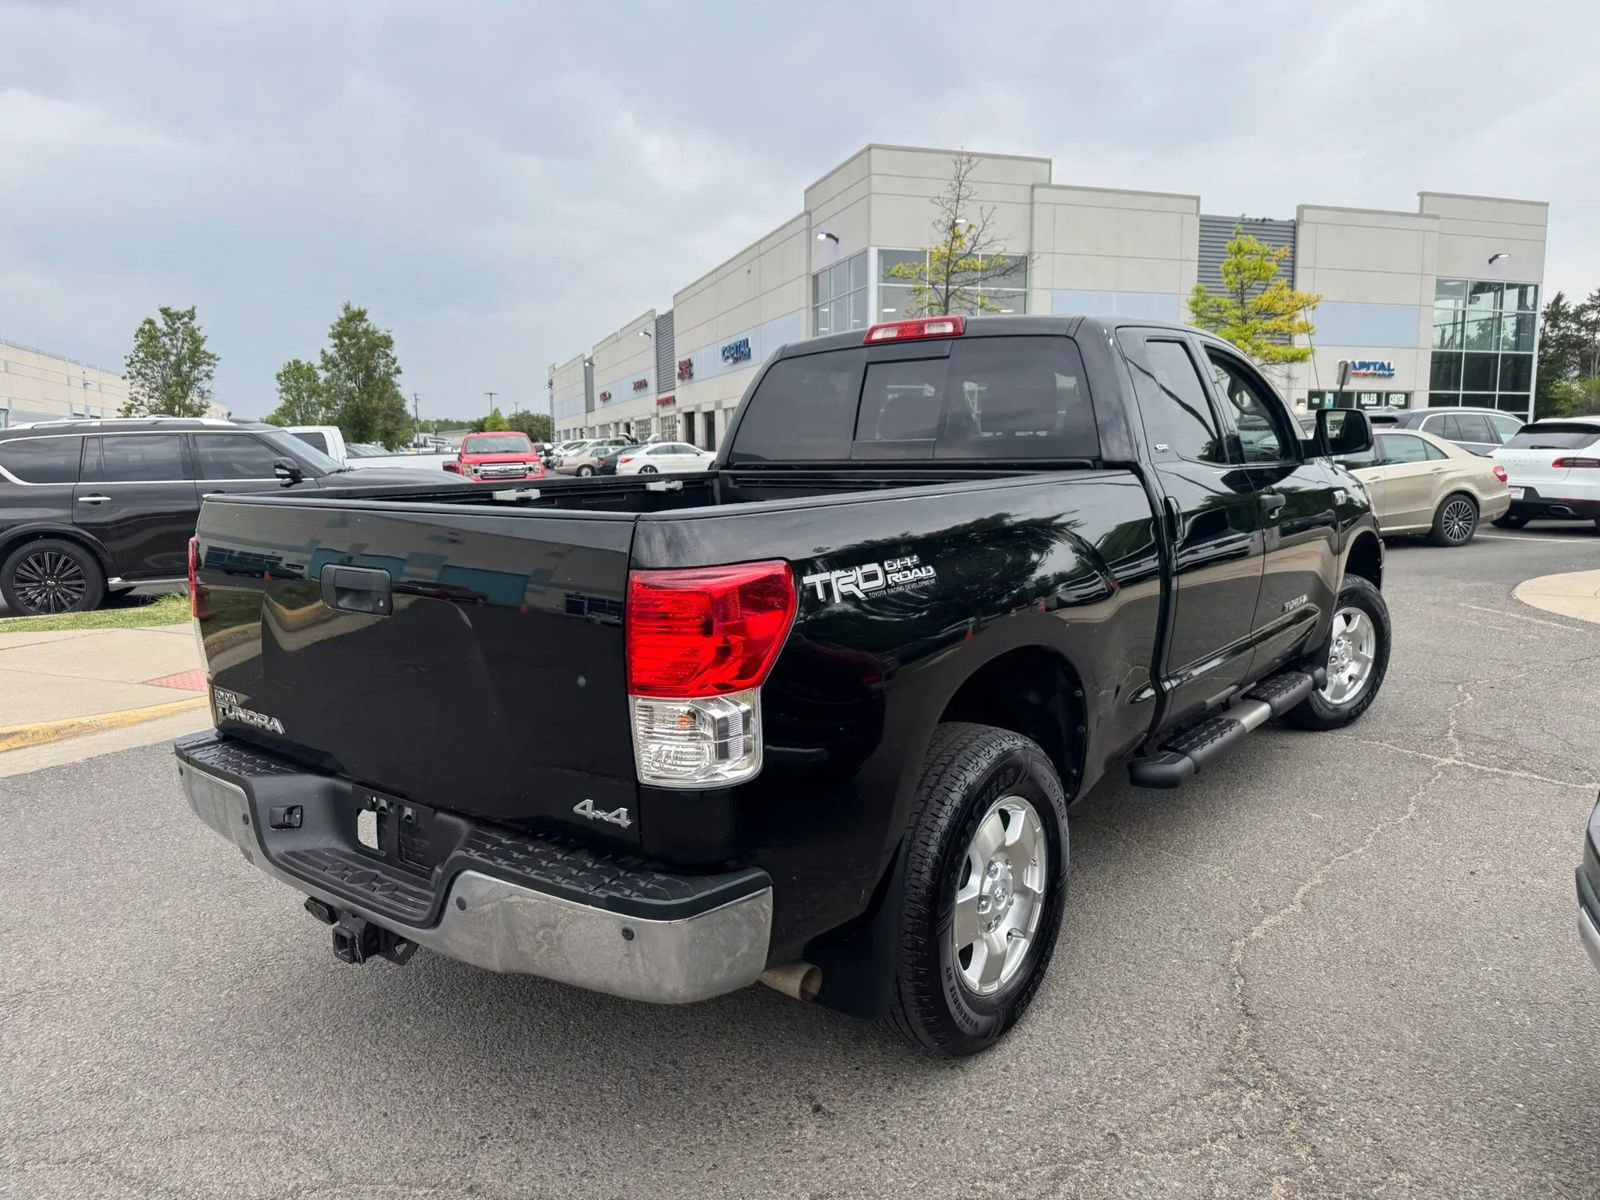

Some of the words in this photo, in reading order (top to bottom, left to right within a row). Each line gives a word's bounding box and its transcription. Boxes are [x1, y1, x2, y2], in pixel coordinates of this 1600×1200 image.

[1349, 360, 1395, 371] APITAL
[1360, 393, 1378, 405] SALES
[1389, 393, 1405, 406] CENTER
[802, 562, 887, 604] TRD
[886, 565, 937, 586] ROAD
[868, 590, 887, 600] TOYOTA
[887, 586, 905, 596] RACING
[904, 578, 937, 592] DEVELOPMENT
[216, 702, 286, 735] TUNDRA
